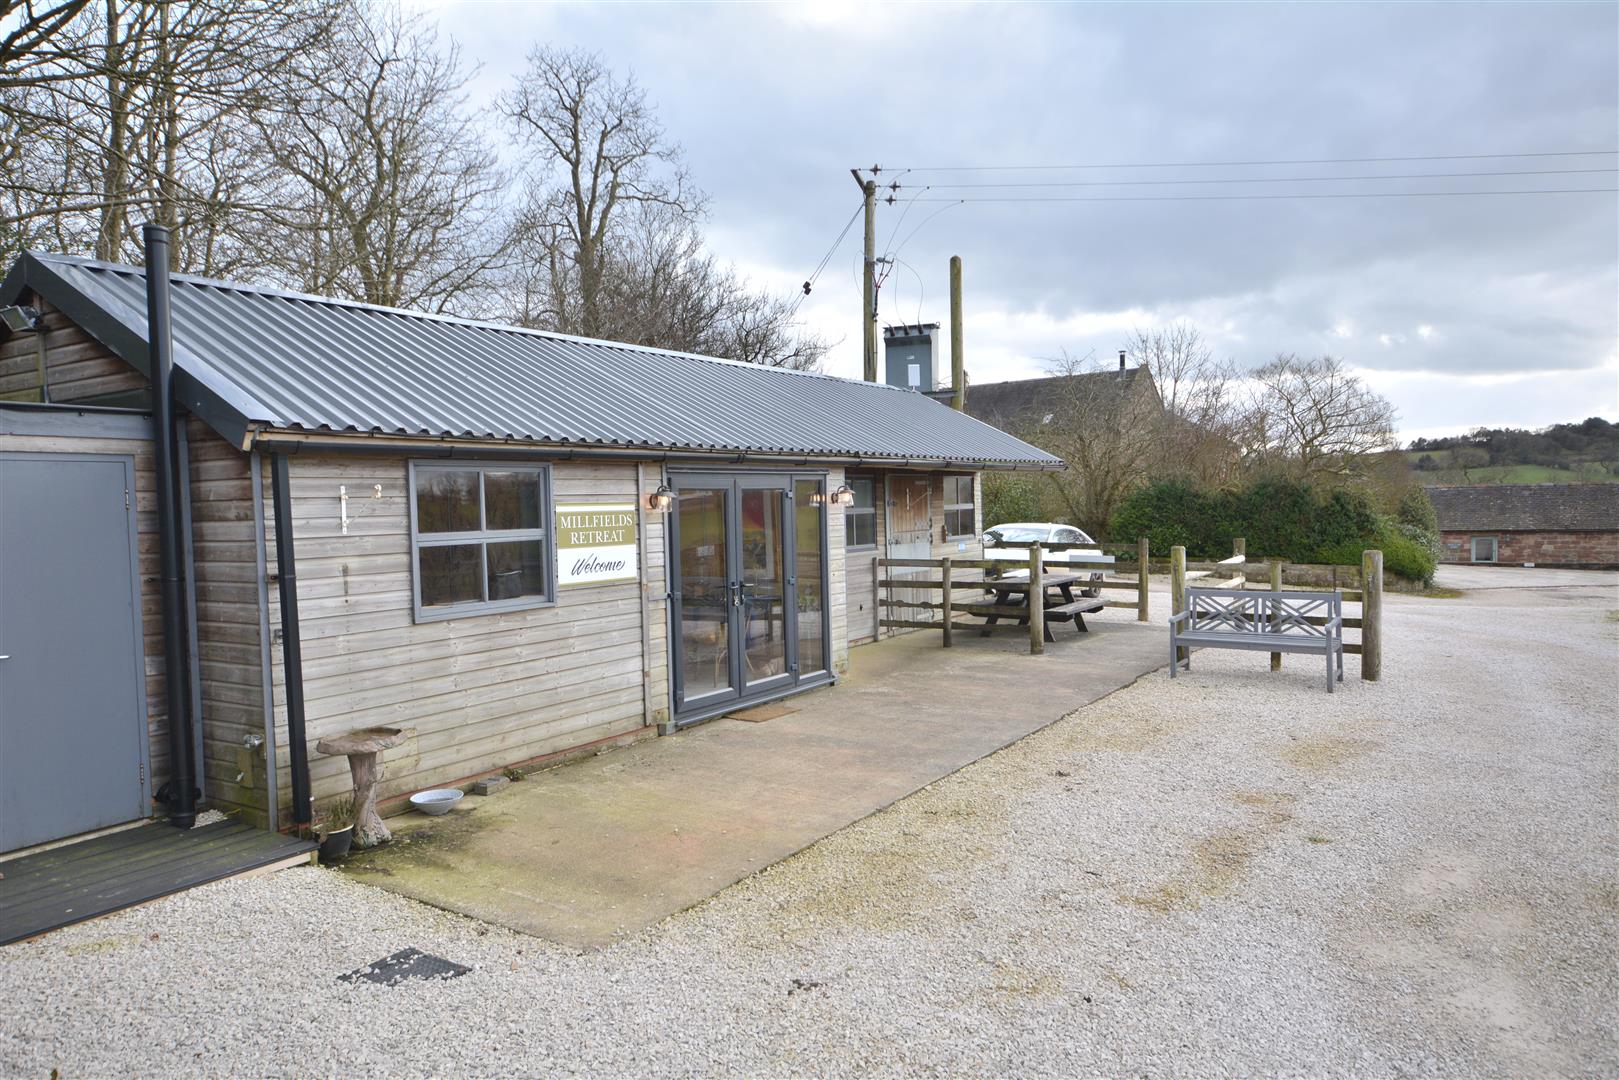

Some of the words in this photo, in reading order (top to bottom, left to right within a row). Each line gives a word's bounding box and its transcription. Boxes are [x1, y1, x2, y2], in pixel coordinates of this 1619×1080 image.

[560, 514, 632, 528] MILLFIELDS
[570, 530, 624, 544] RETREAT
[570, 553, 626, 576] Welcome
